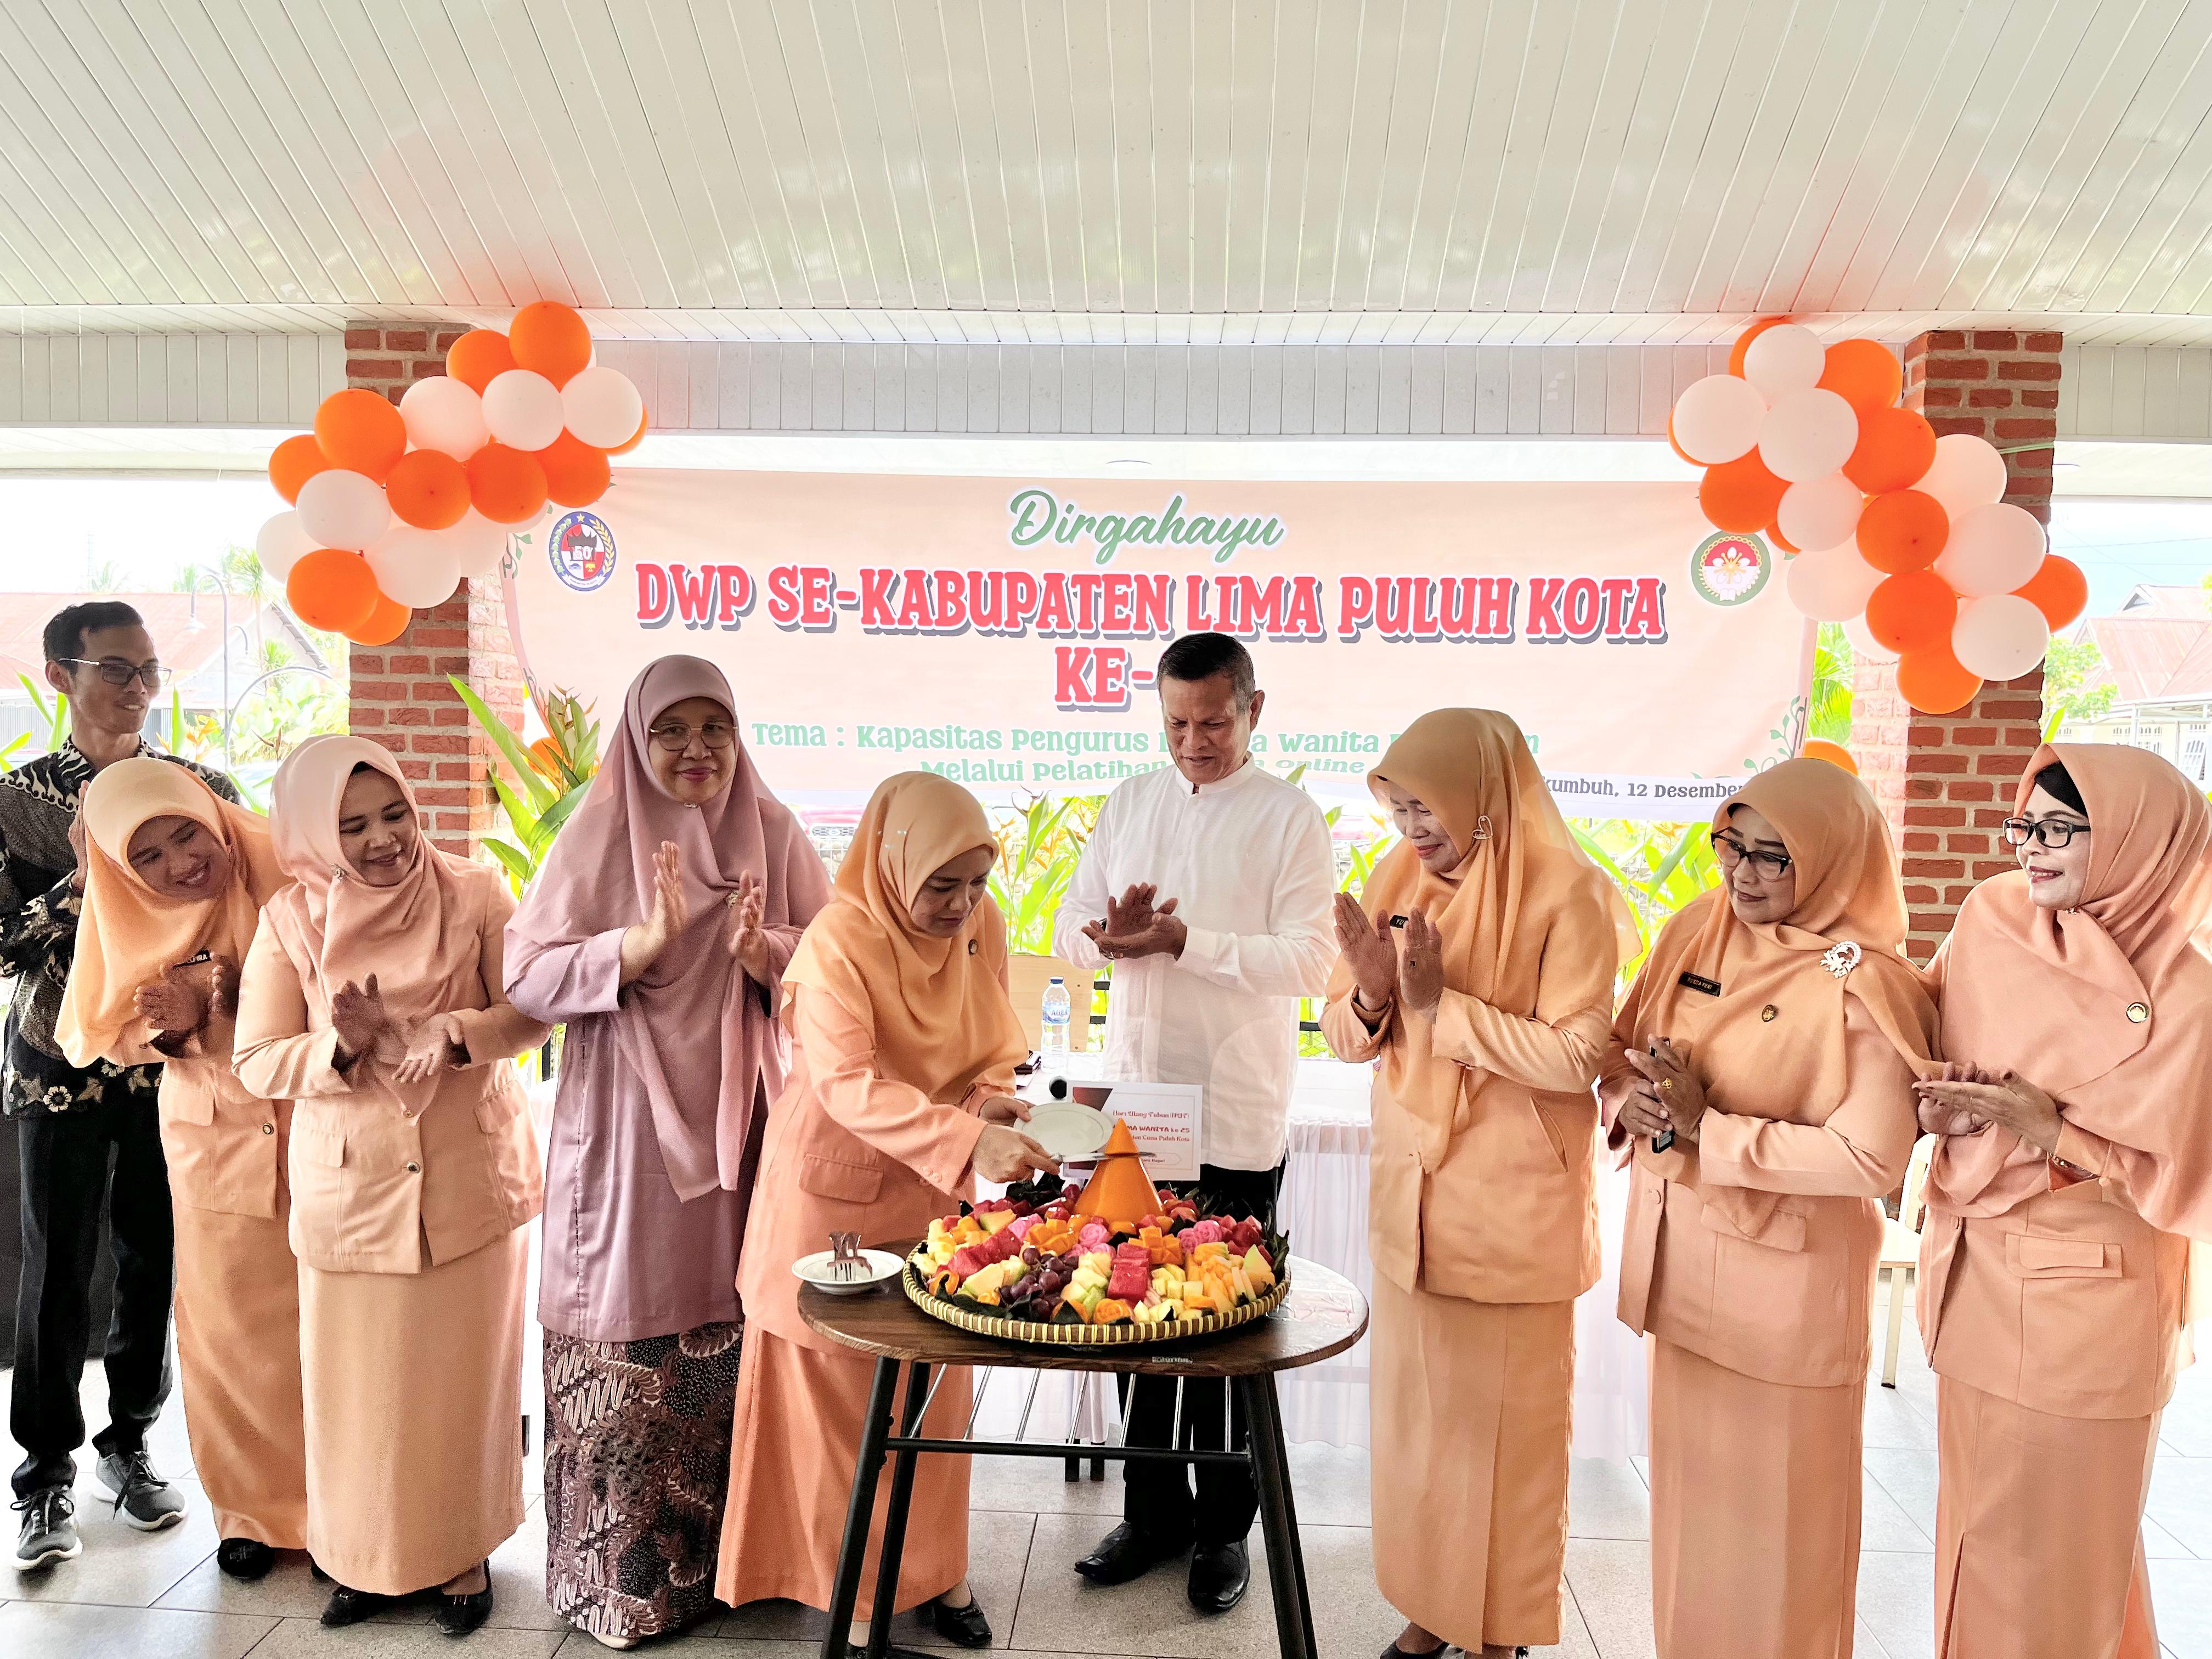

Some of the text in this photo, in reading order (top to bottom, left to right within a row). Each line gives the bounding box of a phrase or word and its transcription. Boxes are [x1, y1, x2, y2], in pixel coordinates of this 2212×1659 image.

[1011, 490, 1284, 564] Dirgahayu
[635, 563, 1664, 635] DWP SE-KABUPATEN LIMA PULUH KOTA
[1054, 646, 1164, 703] KE-
[752, 723, 827, 747] Tema
[836, 726, 844, 747] :
[856, 725, 1002, 752] Kapasitas
[1011, 728, 1149, 756] Pengurus
[1278, 731, 1379, 753] Wanita
[1627, 783, 1647, 797] 12
